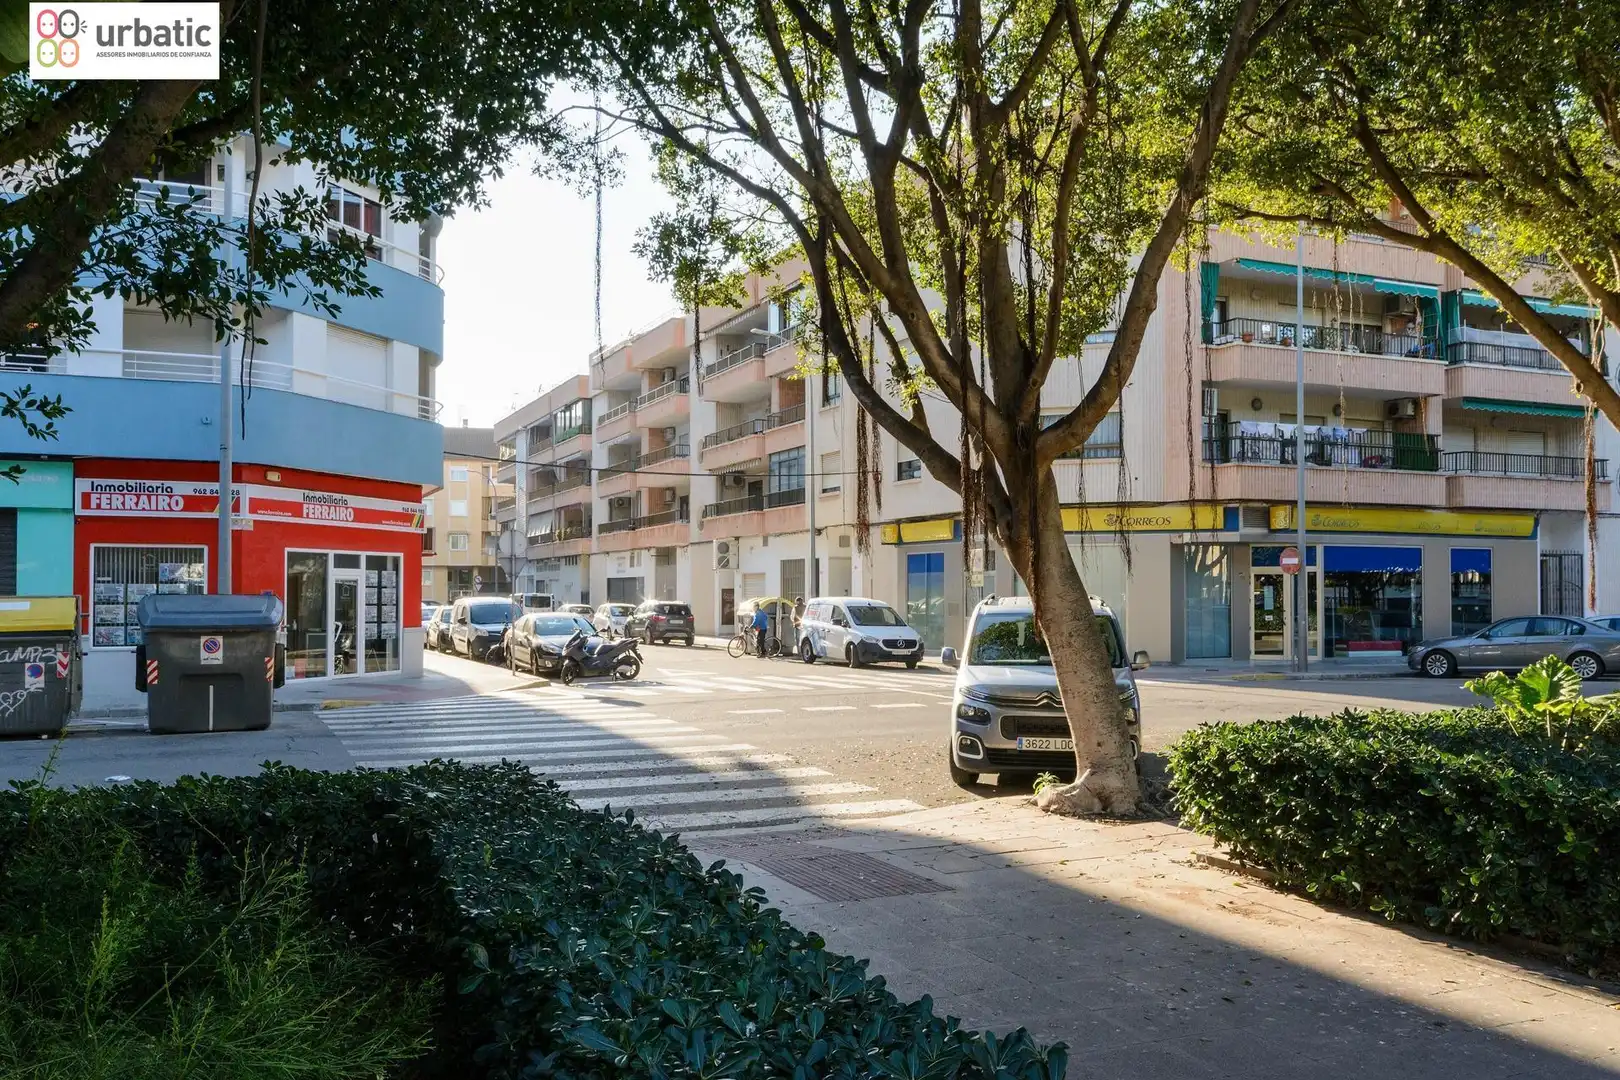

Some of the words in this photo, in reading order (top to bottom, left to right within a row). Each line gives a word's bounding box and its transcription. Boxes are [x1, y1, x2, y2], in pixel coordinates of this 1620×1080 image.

[90, 481, 173, 494] Inmobiliaria
[90, 493, 184, 511] FERRAIRO
[303, 492, 349, 506] Inmobiliaria
[303, 503, 354, 521] FERRAIRO
[1120, 516, 1171, 526] CORREOS
[1025, 739, 1051, 749] 3622
